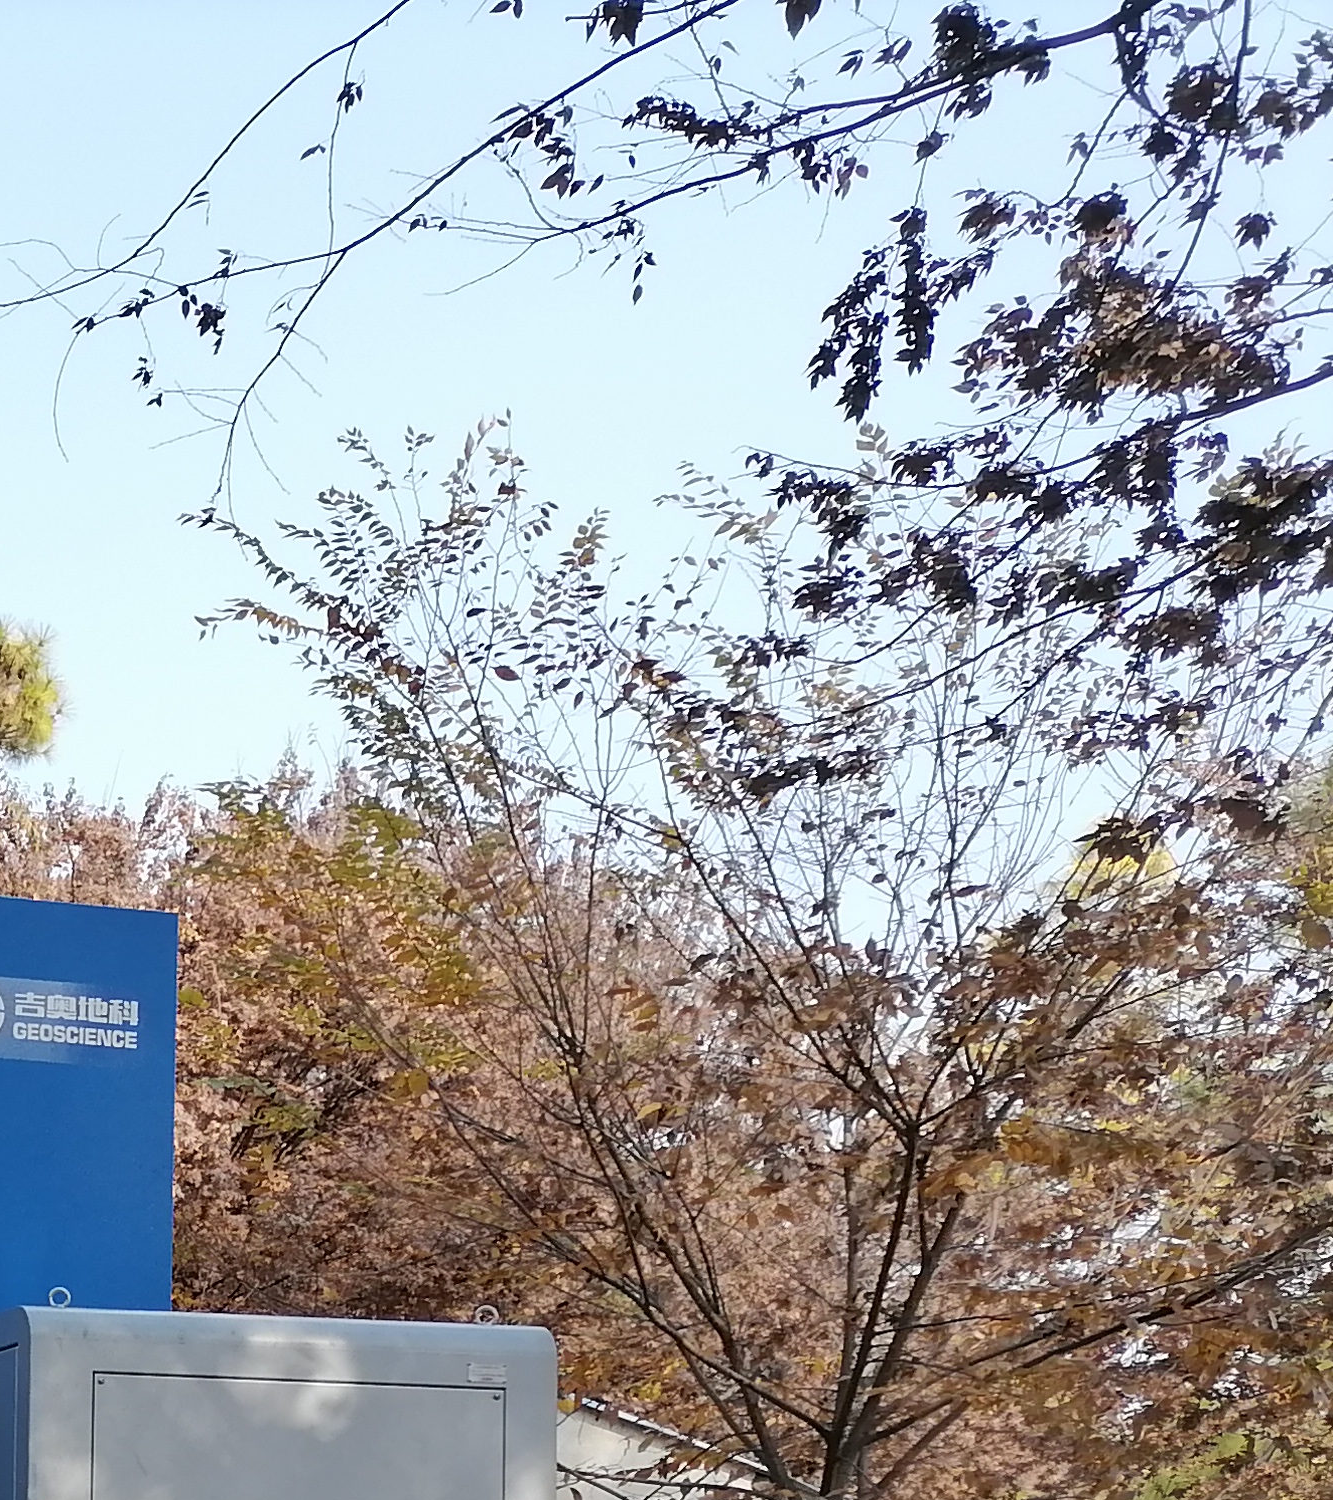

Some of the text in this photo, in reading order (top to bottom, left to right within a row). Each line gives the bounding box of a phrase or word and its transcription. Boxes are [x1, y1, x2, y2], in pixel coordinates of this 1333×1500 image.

[14, 991, 139, 1025] 吉奥地科
[12, 1022, 138, 1050] GEOSCIENCE
